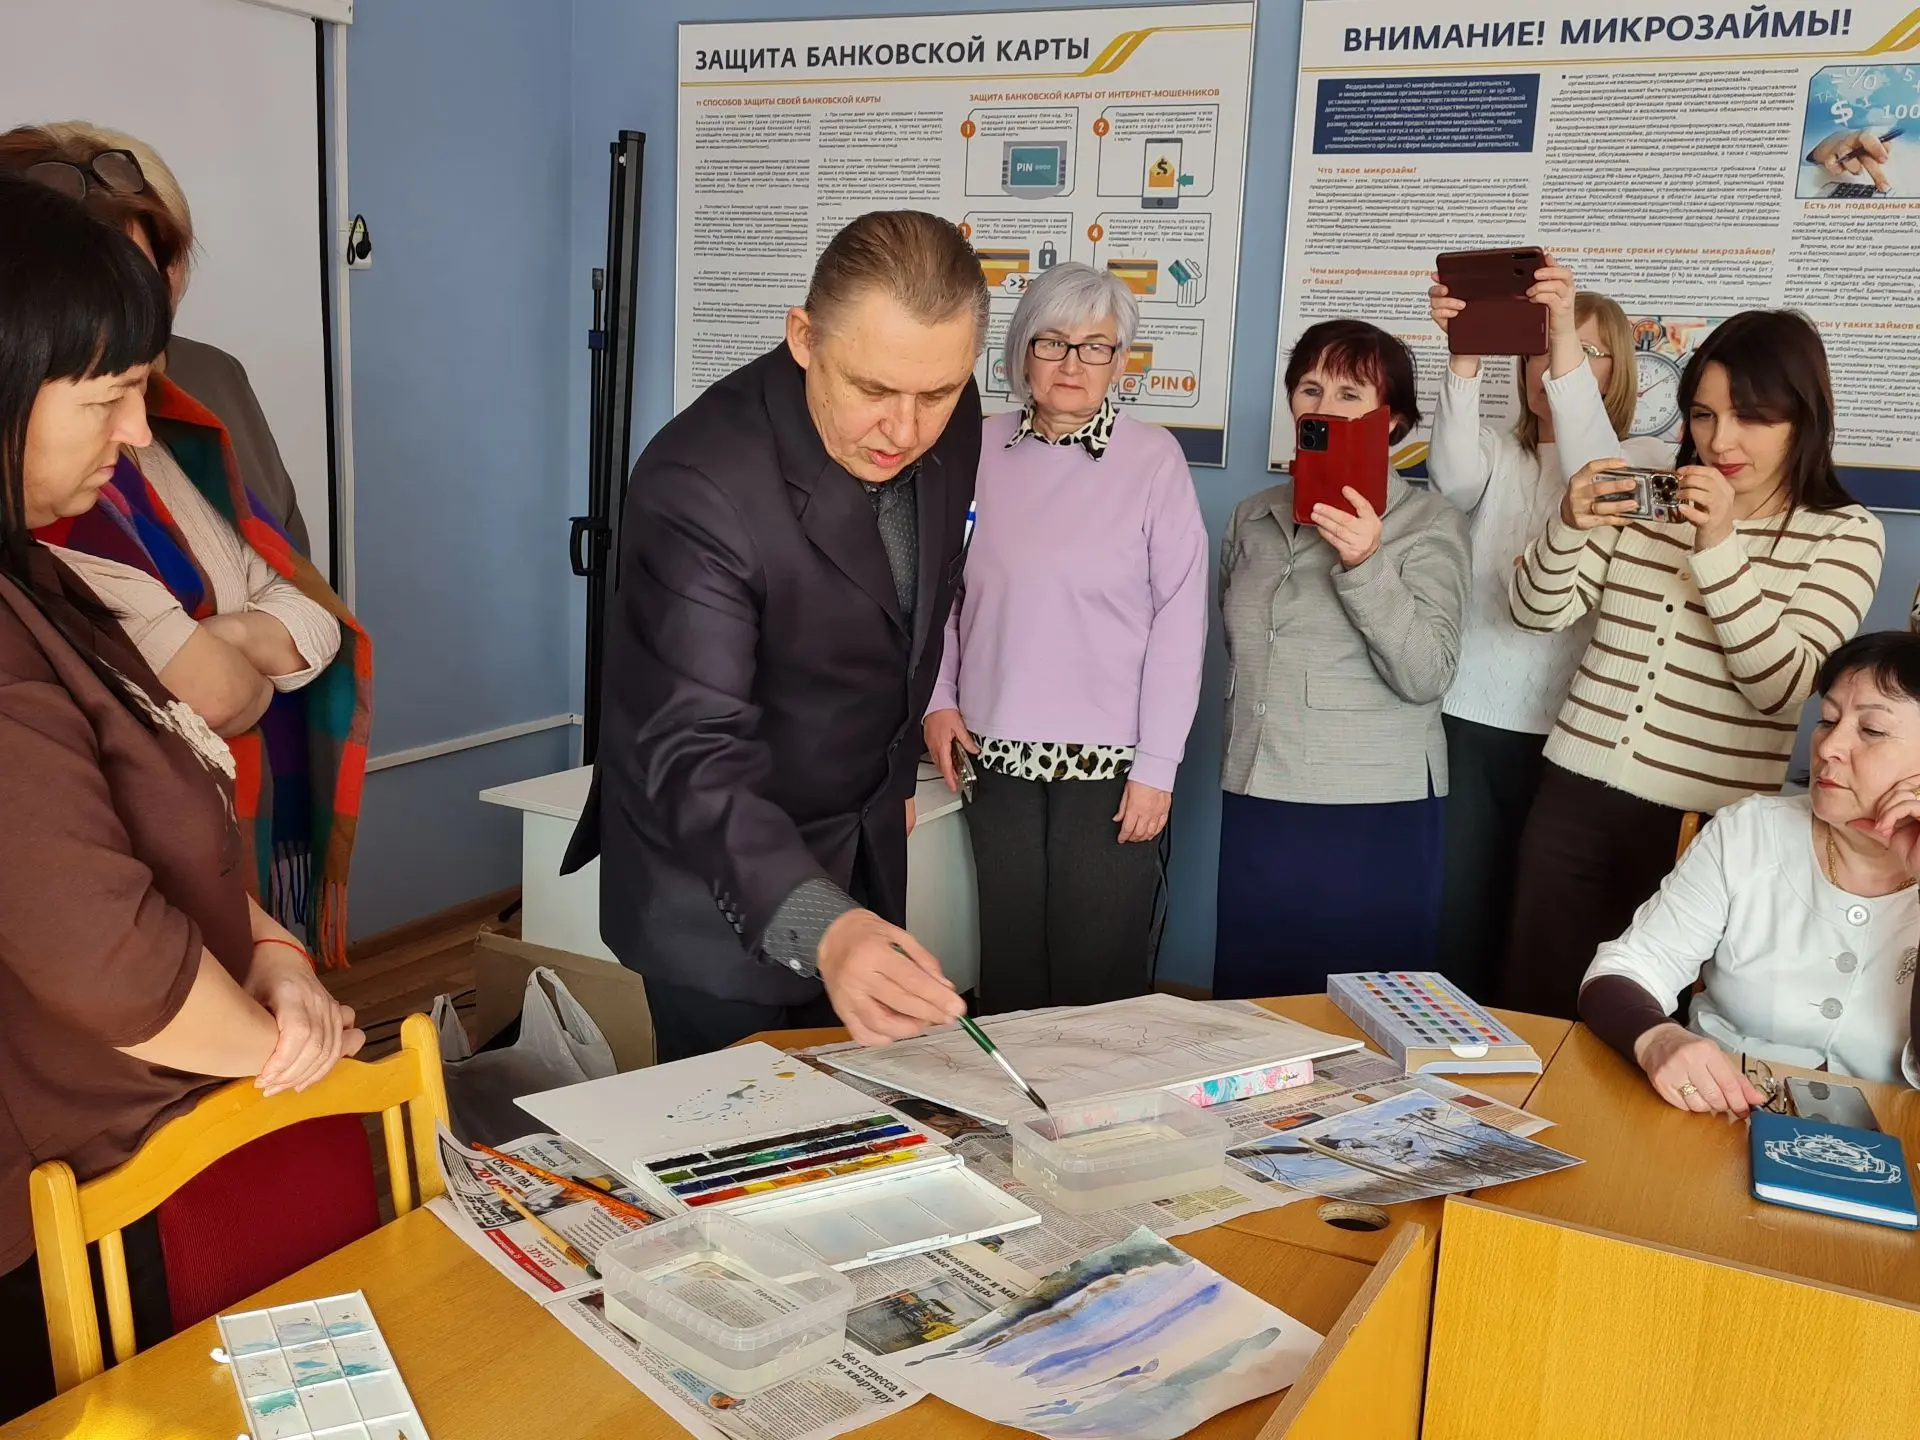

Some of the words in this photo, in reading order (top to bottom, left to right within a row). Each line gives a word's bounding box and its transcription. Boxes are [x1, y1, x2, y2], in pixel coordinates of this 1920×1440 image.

[1343, 21, 1544, 51] ВНИМАНИЕ!
[1561, 4, 1851, 44] МИКРОЗАЙМЫ!
[695, 47, 795, 74] ЗАЩИТА
[807, 36, 984, 67] БАНКОВСКОЙ
[996, 38, 1090, 62] КАРТЫ
[702, 98, 742, 108] СПОСОБОВ
[743, 98, 776, 108] ЗАЩИТЫ
[775, 95, 802, 106] СВОЕЙ
[801, 94, 853, 106] БАНКОВСКОЙ
[855, 96, 881, 105] КАРТЫ
[969, 93, 1003, 103] ЗАЩИТА
[1005, 89, 1062, 101] БАНКОВСКОЙ
[1063, 91, 1092, 100] КАРТЫ
[1094, 91, 1105, 99] ОТ
[1108, 88, 1219, 99] ИНТЕРНЕТ-МОШЕННИКОВ
[1098, 121, 1105, 132] 2
[1016, 163, 1033, 172] PIN
[1318, 166, 1332, 174] Что
[1363, 165, 1417, 176] микрозайм?
[1804, 201, 1826, 210] Есть
[1845, 203, 1906, 211] подводные
[1544, 244, 1579, 253] Каковы
[1582, 247, 1622, 255] средние
[1626, 247, 1655, 256] сроки
[1664, 247, 1698, 256] суммы
[1702, 245, 1775, 256] микрозаймов?
[1310, 266, 1326, 275] Чем
[1327, 266, 1408, 278] микрофинансовая
[1409, 270, 1432, 278] орга
[1314, 276, 1343, 285] банка?
[1151, 376, 1178, 390] PIN
[492, 1159, 518, 1177] ОКОН
[513, 1175, 535, 1188] ПВХ
[922, 1251, 950, 1269] овые
[948, 1267, 996, 1299] проезды
[989, 1280, 1002, 1288] и
[841, 1352, 859, 1367] без
[858, 1364, 898, 1393] стресса
[827, 1358, 847, 1371] ую
[844, 1368, 895, 1404] квартиру
